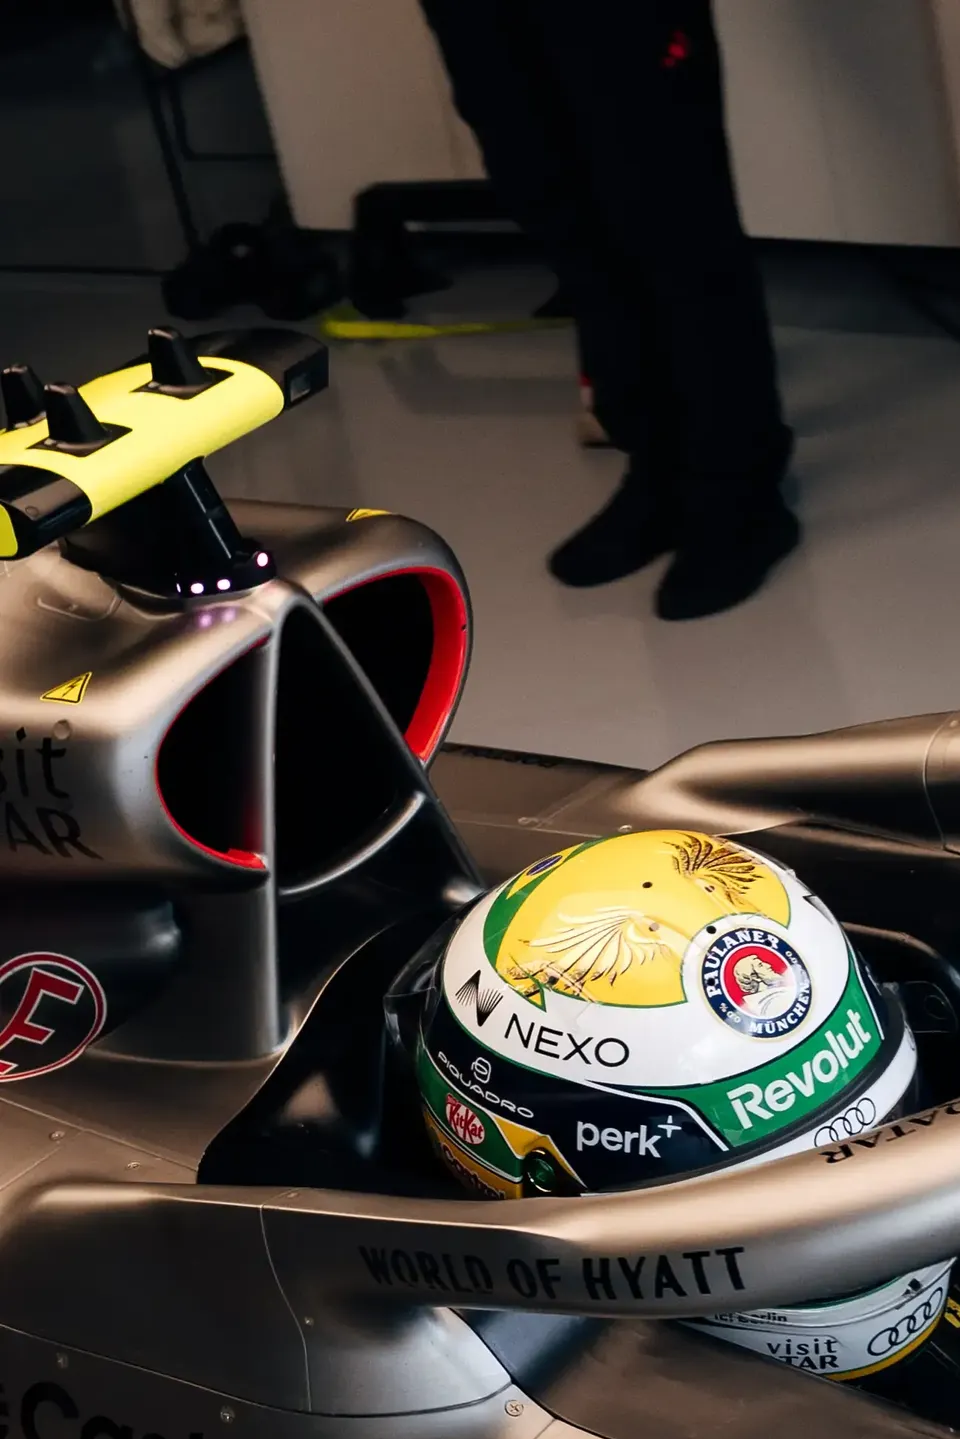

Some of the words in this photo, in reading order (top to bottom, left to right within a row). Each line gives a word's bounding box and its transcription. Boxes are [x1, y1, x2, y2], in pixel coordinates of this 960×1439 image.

[703, 929, 780, 998] PAULANER
[747, 979, 811, 1035] MÜNCHEN
[503, 1013, 631, 1068] NEXO
[437, 1050, 534, 1119] PIQUADRO
[726, 1008, 872, 1130] Revolut
[446, 1100, 484, 1143] KitKat
[358, 1245, 494, 1295] WORLD
[506, 1257, 561, 1299] OF
[581, 1246, 746, 1300] HYATT
[766, 1338, 840, 1355] visit
